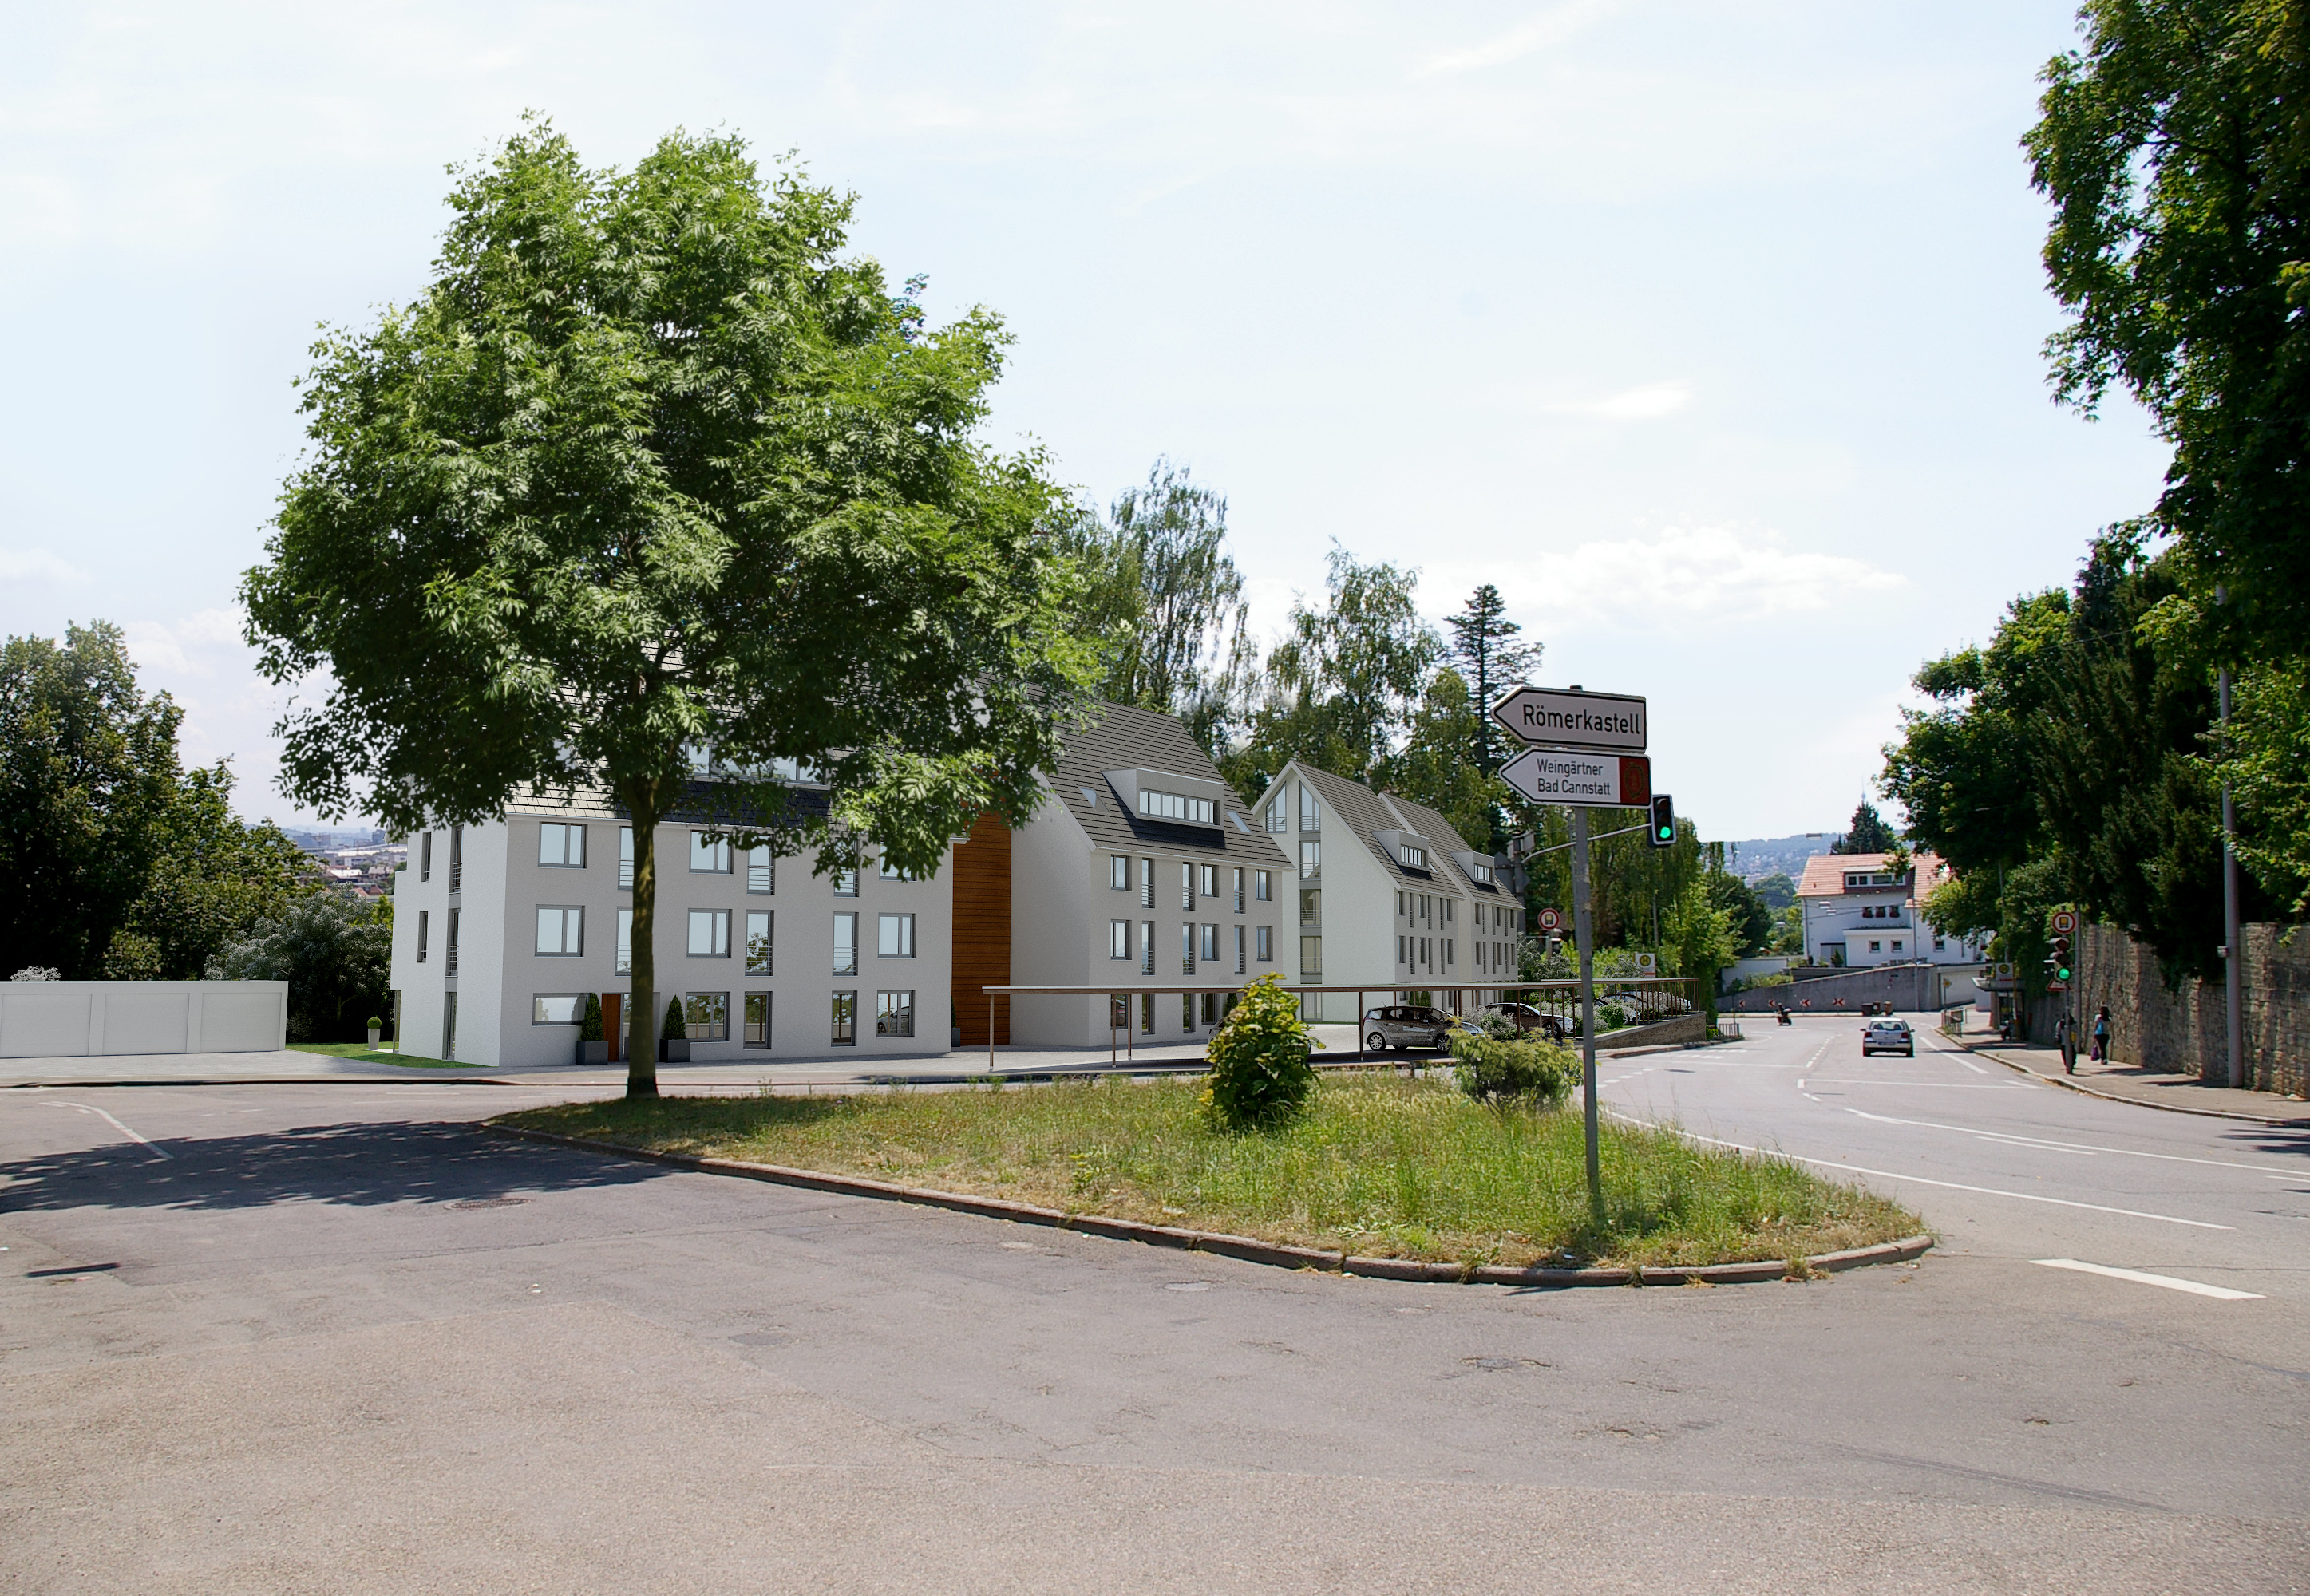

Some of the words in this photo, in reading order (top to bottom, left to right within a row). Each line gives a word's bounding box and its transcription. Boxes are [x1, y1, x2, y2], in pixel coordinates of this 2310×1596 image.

[1523, 704, 1640, 734] Römerkastell
[1537, 758, 1603, 777] Weingärtner
[1537, 778, 1558, 792] Bad
[1561, 779, 1610, 795] Cannstatt
